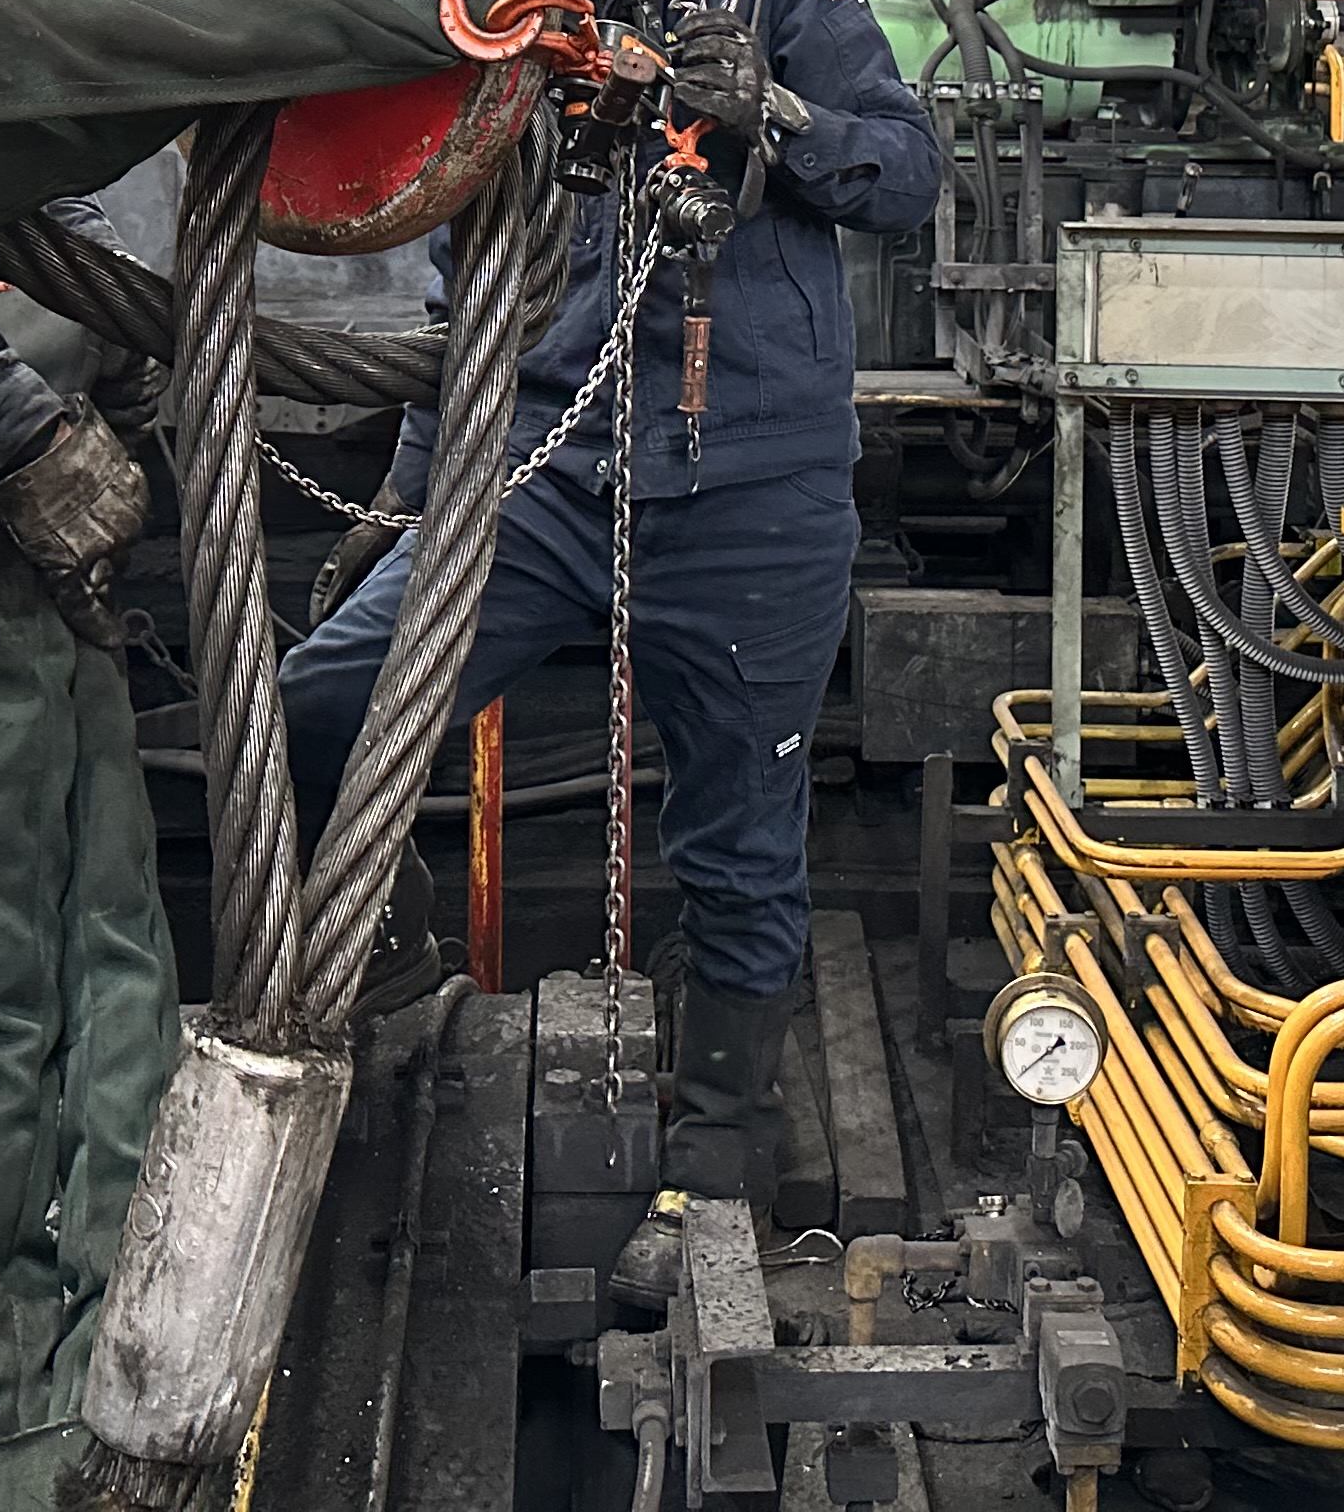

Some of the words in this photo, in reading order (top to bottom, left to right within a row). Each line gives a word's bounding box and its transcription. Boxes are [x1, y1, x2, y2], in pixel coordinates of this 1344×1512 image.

[1029, 1017, 1044, 1027] 100
[1059, 1019, 1074, 1029] 150
[1015, 1037, 1026, 1047] 50
[1069, 1041, 1087, 1050] 200
[1061, 1067, 1077, 1077] 250
